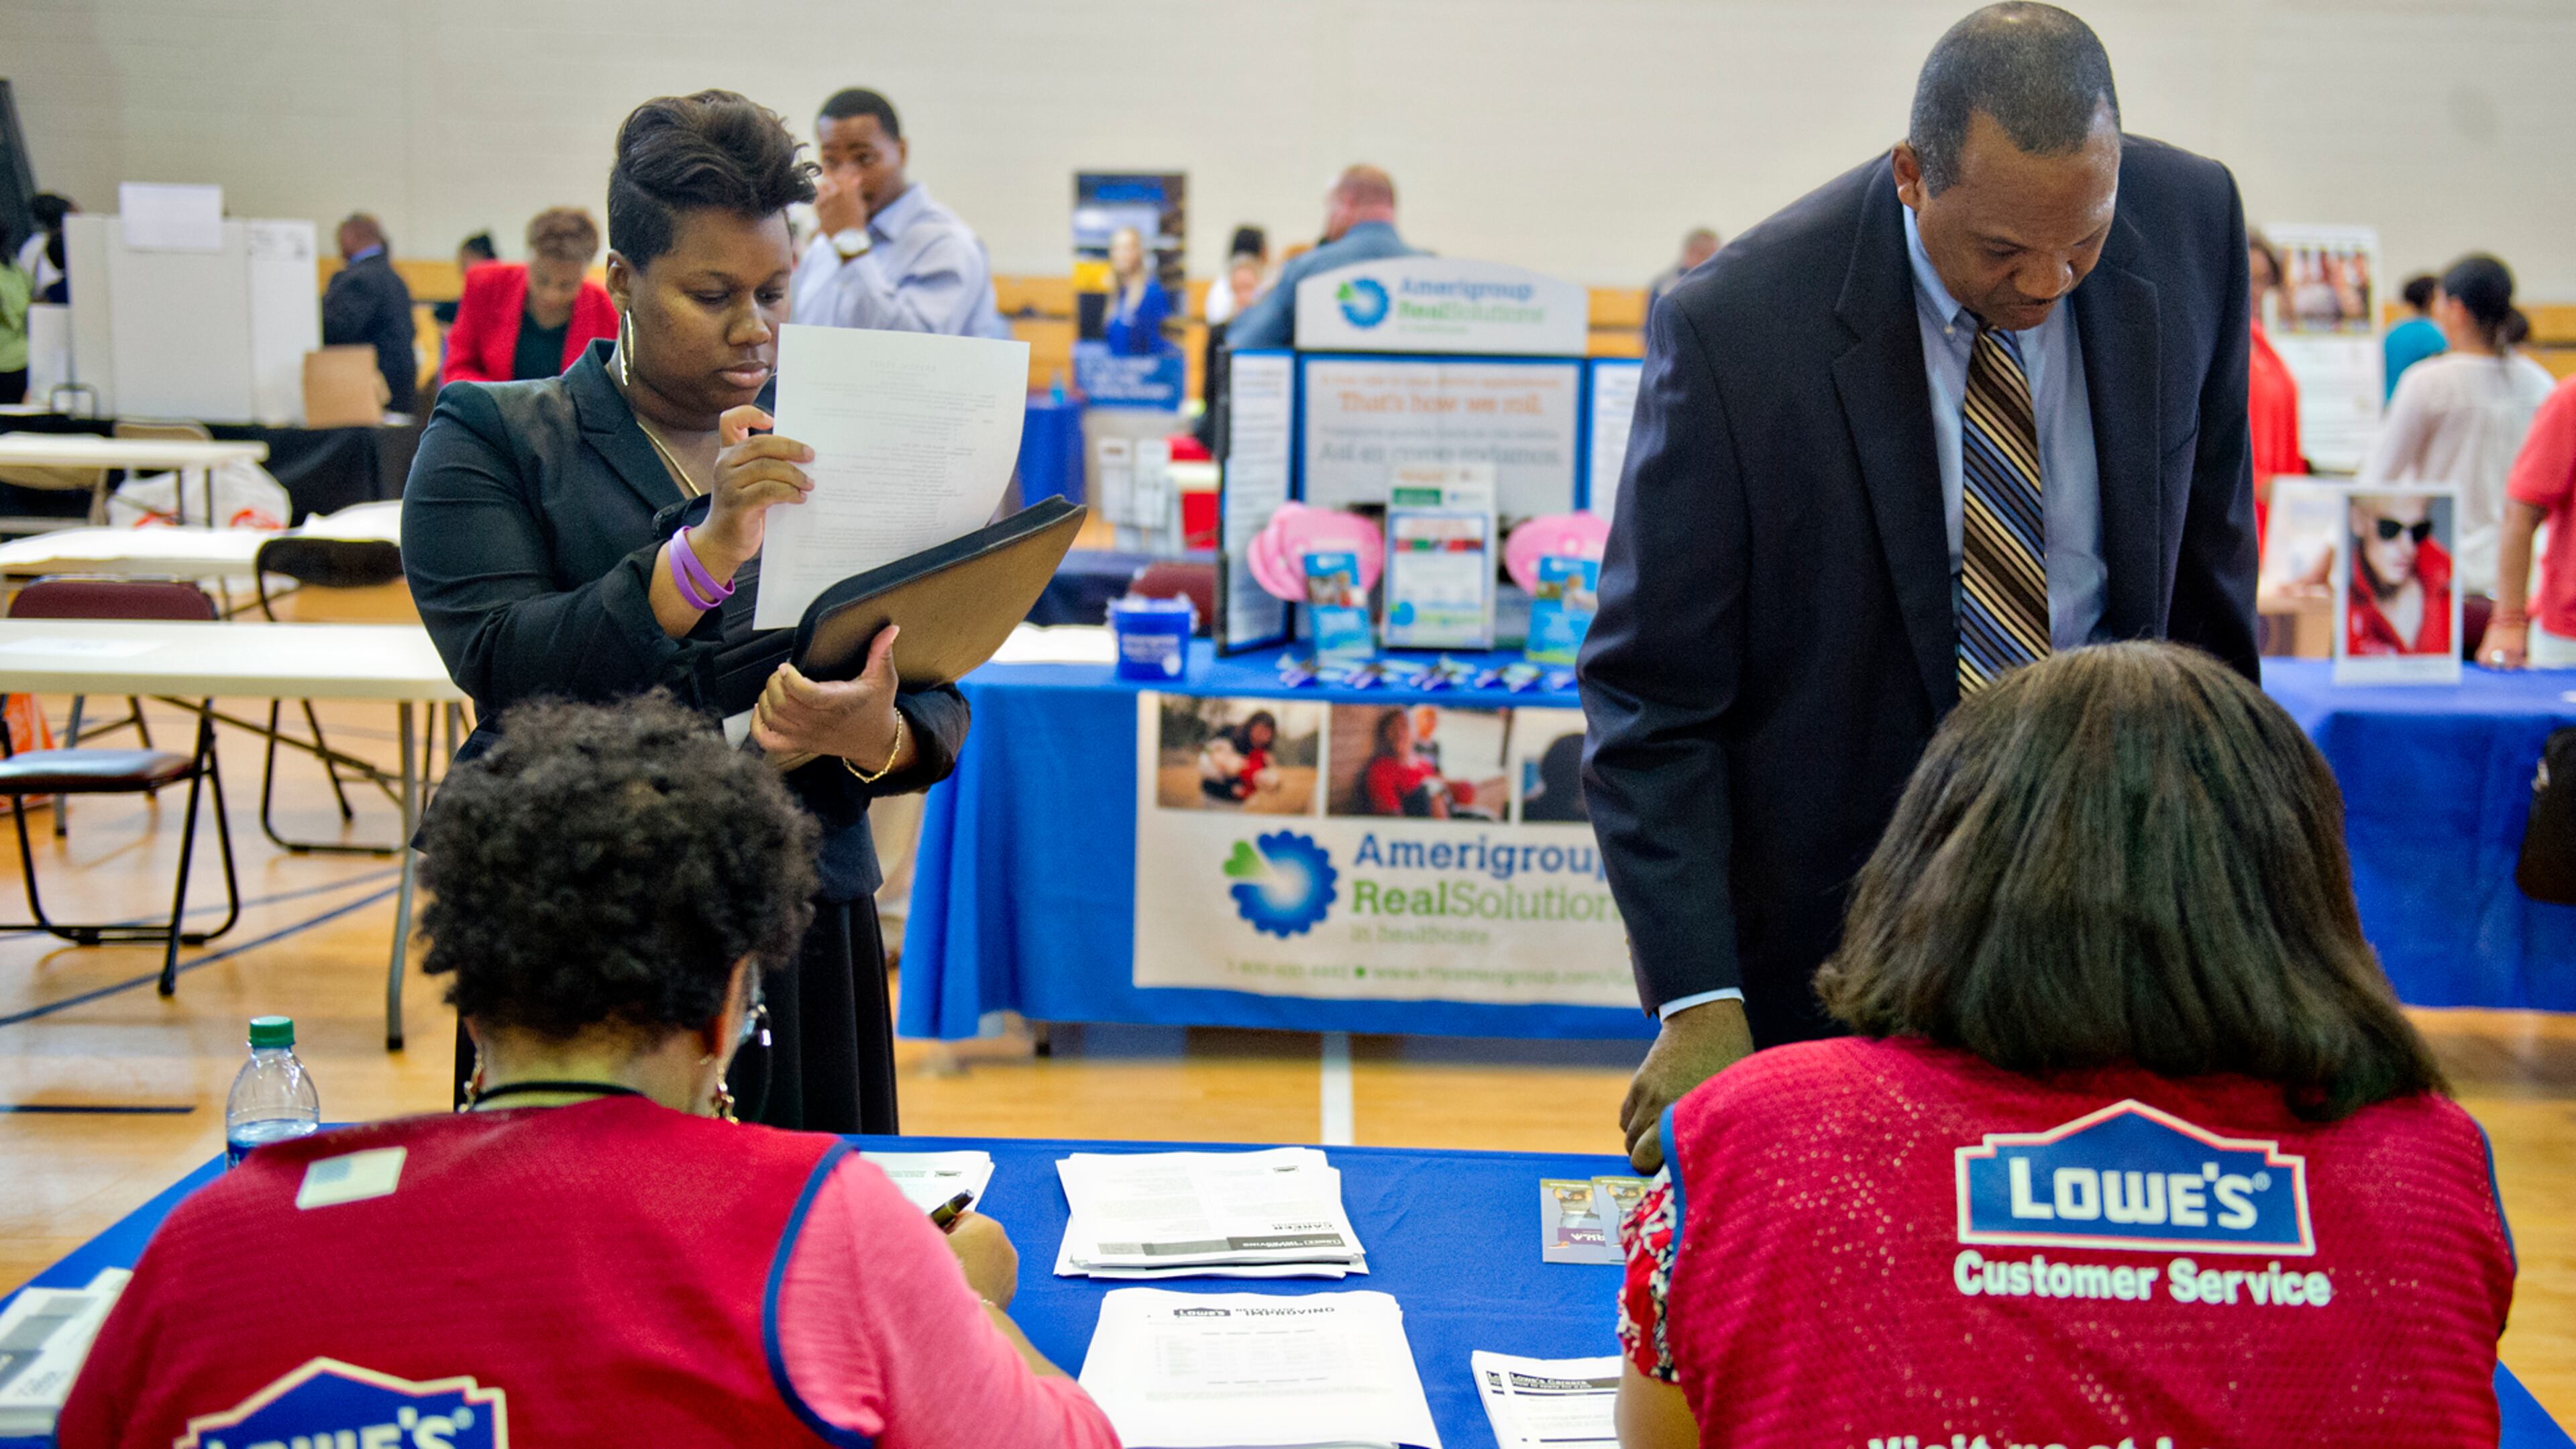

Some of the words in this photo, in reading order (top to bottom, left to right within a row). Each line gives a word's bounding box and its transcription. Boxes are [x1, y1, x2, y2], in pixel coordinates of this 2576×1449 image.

[1352, 879, 1621, 922] RealSolution
[2009, 1157, 2258, 1230] LOWE'S
[1953, 1249, 2159, 1301] Customer
[2167, 1257, 2332, 1307] Service
